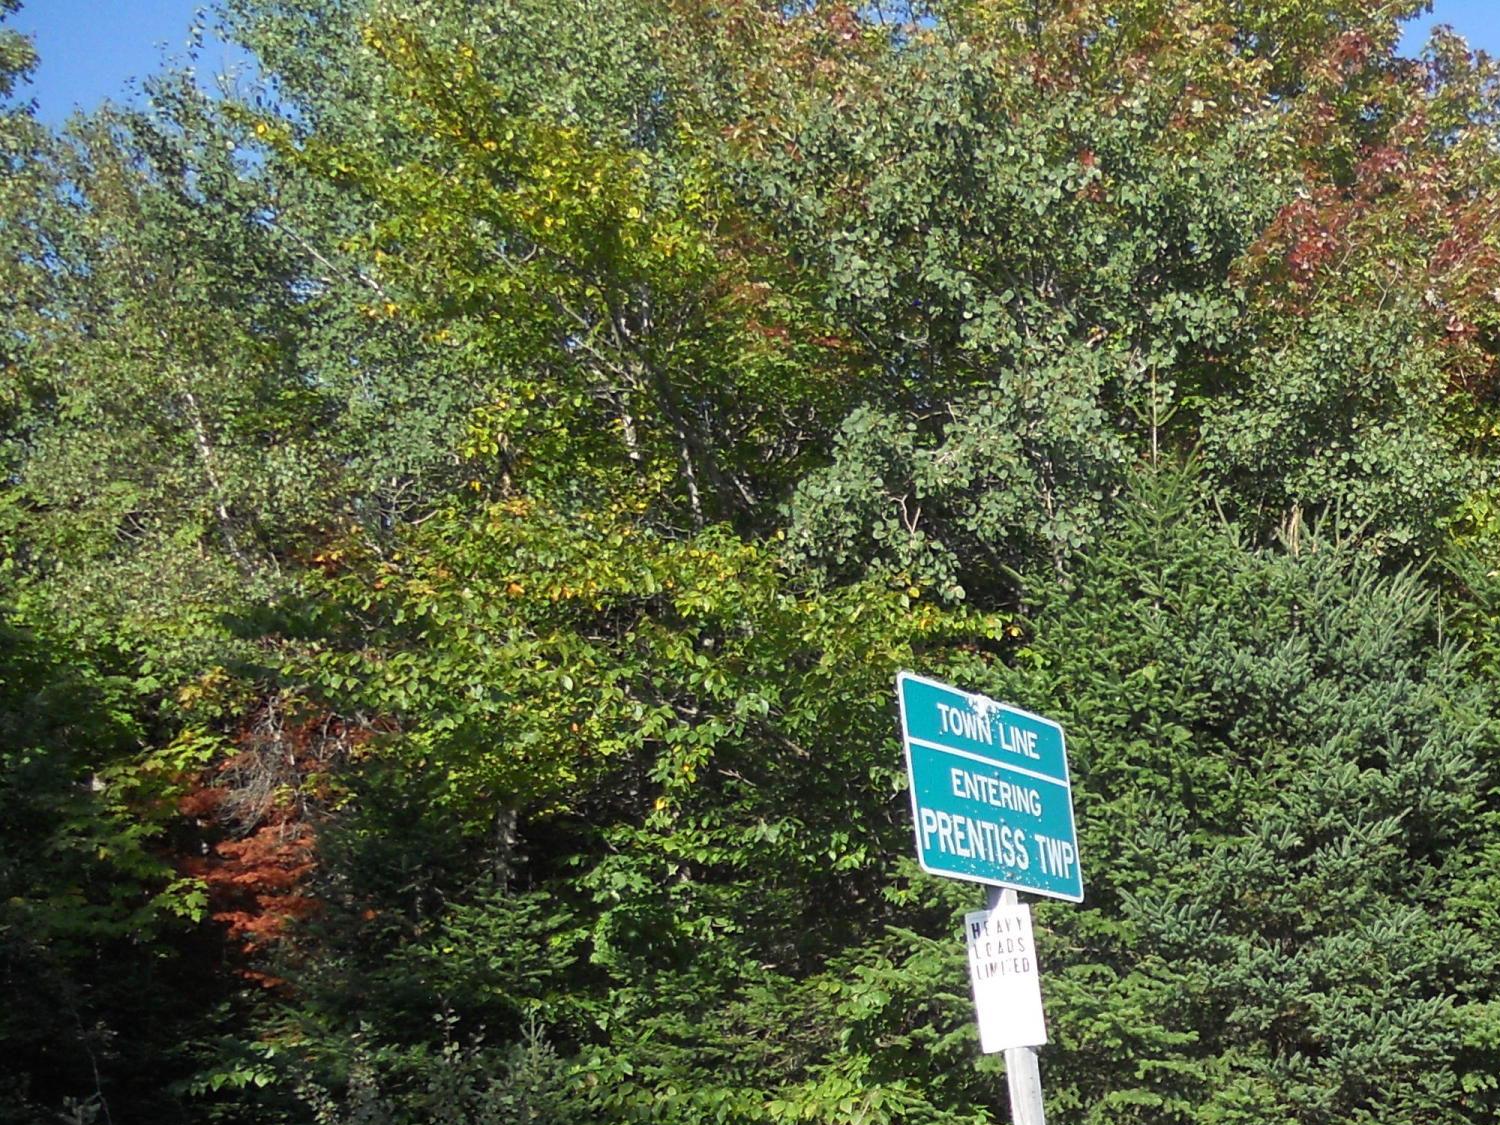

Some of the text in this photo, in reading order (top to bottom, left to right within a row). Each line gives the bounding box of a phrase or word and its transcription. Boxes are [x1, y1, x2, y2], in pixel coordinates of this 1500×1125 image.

[936, 702, 1041, 760] TOWN LINE
[951, 767, 1042, 817] ENTERING
[920, 807, 1075, 879] PRENTISS TWP
[971, 916, 1023, 939] HEAVY
[973, 937, 1026, 960] LOADS
